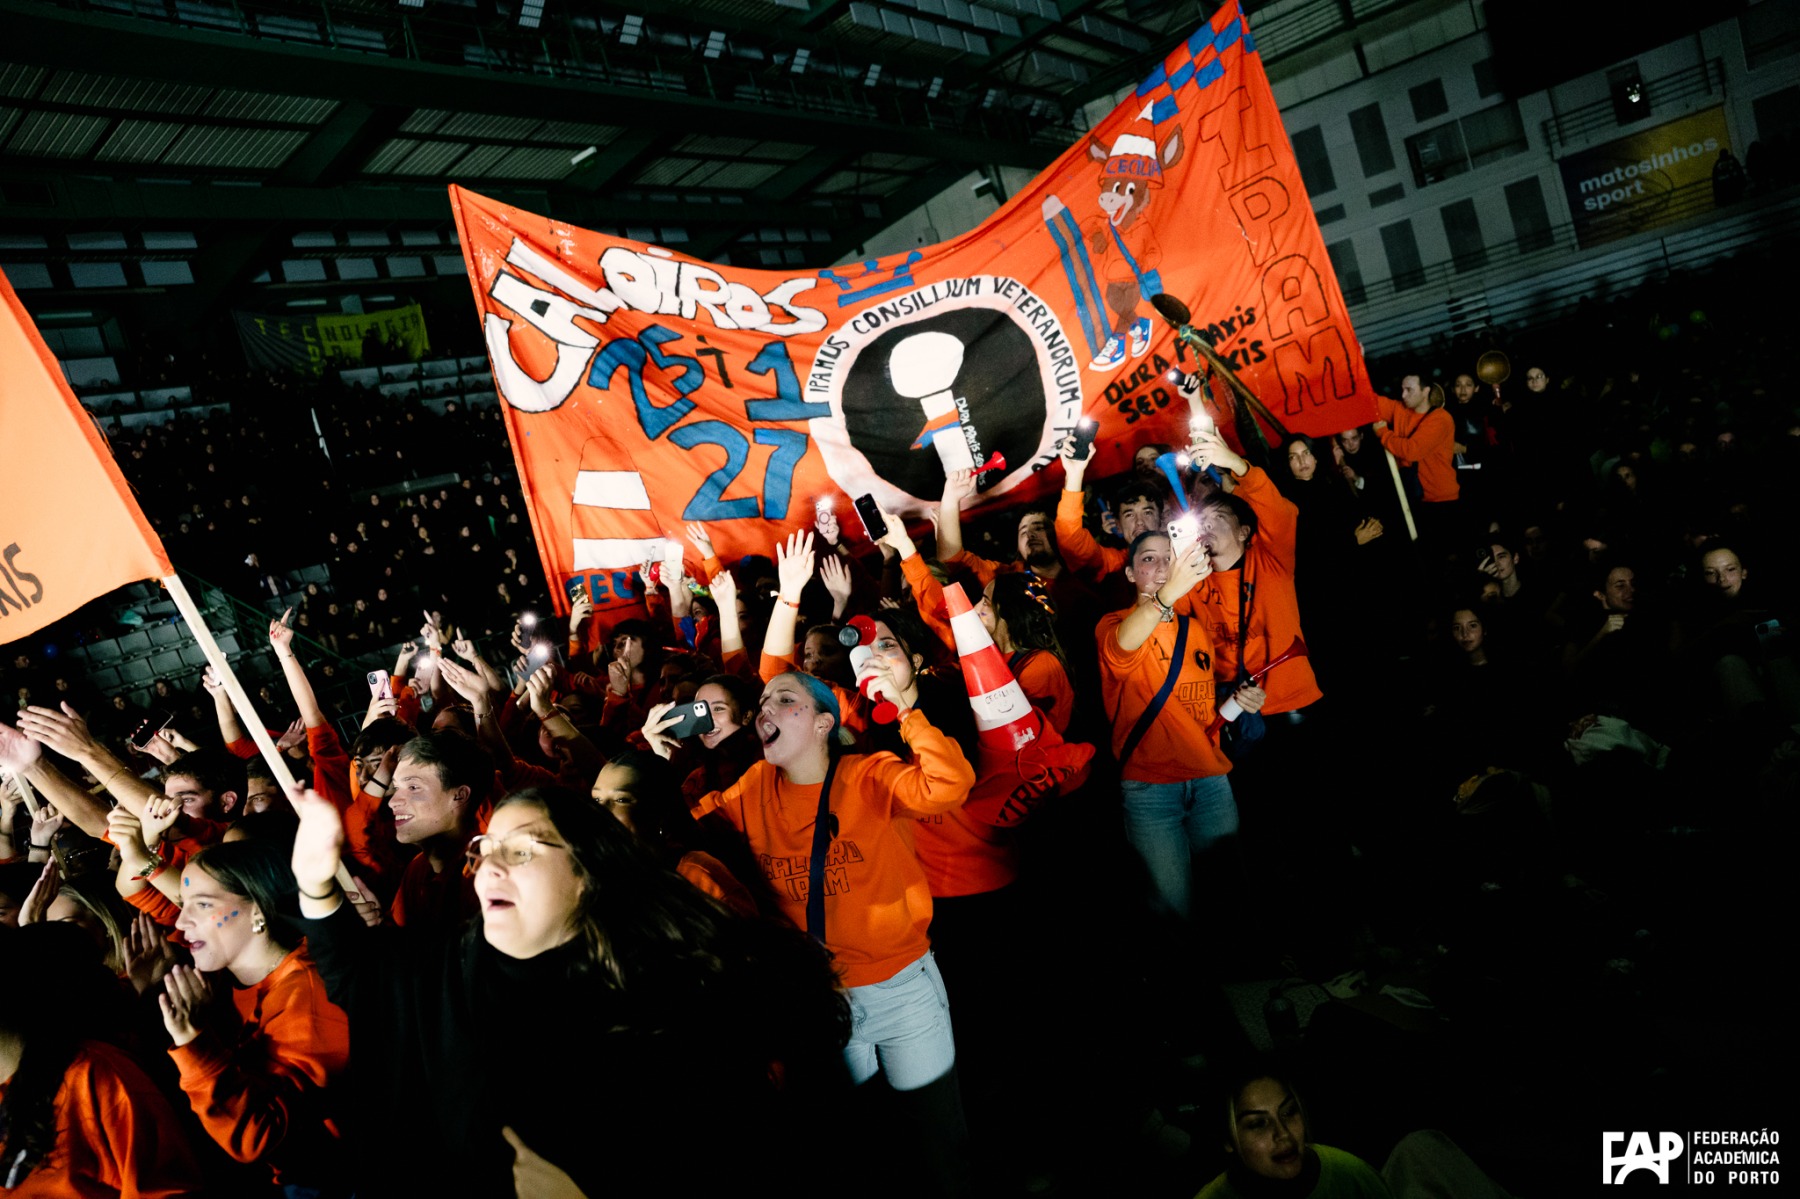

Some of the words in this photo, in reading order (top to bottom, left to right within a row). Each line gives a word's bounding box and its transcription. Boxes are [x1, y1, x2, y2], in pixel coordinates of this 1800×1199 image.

[1579, 137, 1718, 194] matosinhos
[1583, 180, 1645, 211] sport
[1198, 86, 1356, 416] IPAM
[993, 277, 1080, 405] VETERANORUM
[1104, 353, 1170, 405] DURA
[586, 323, 705, 441] 25
[745, 341, 832, 421] 1
[1118, 387, 1171, 424] SED
[667, 420, 808, 521] 27
